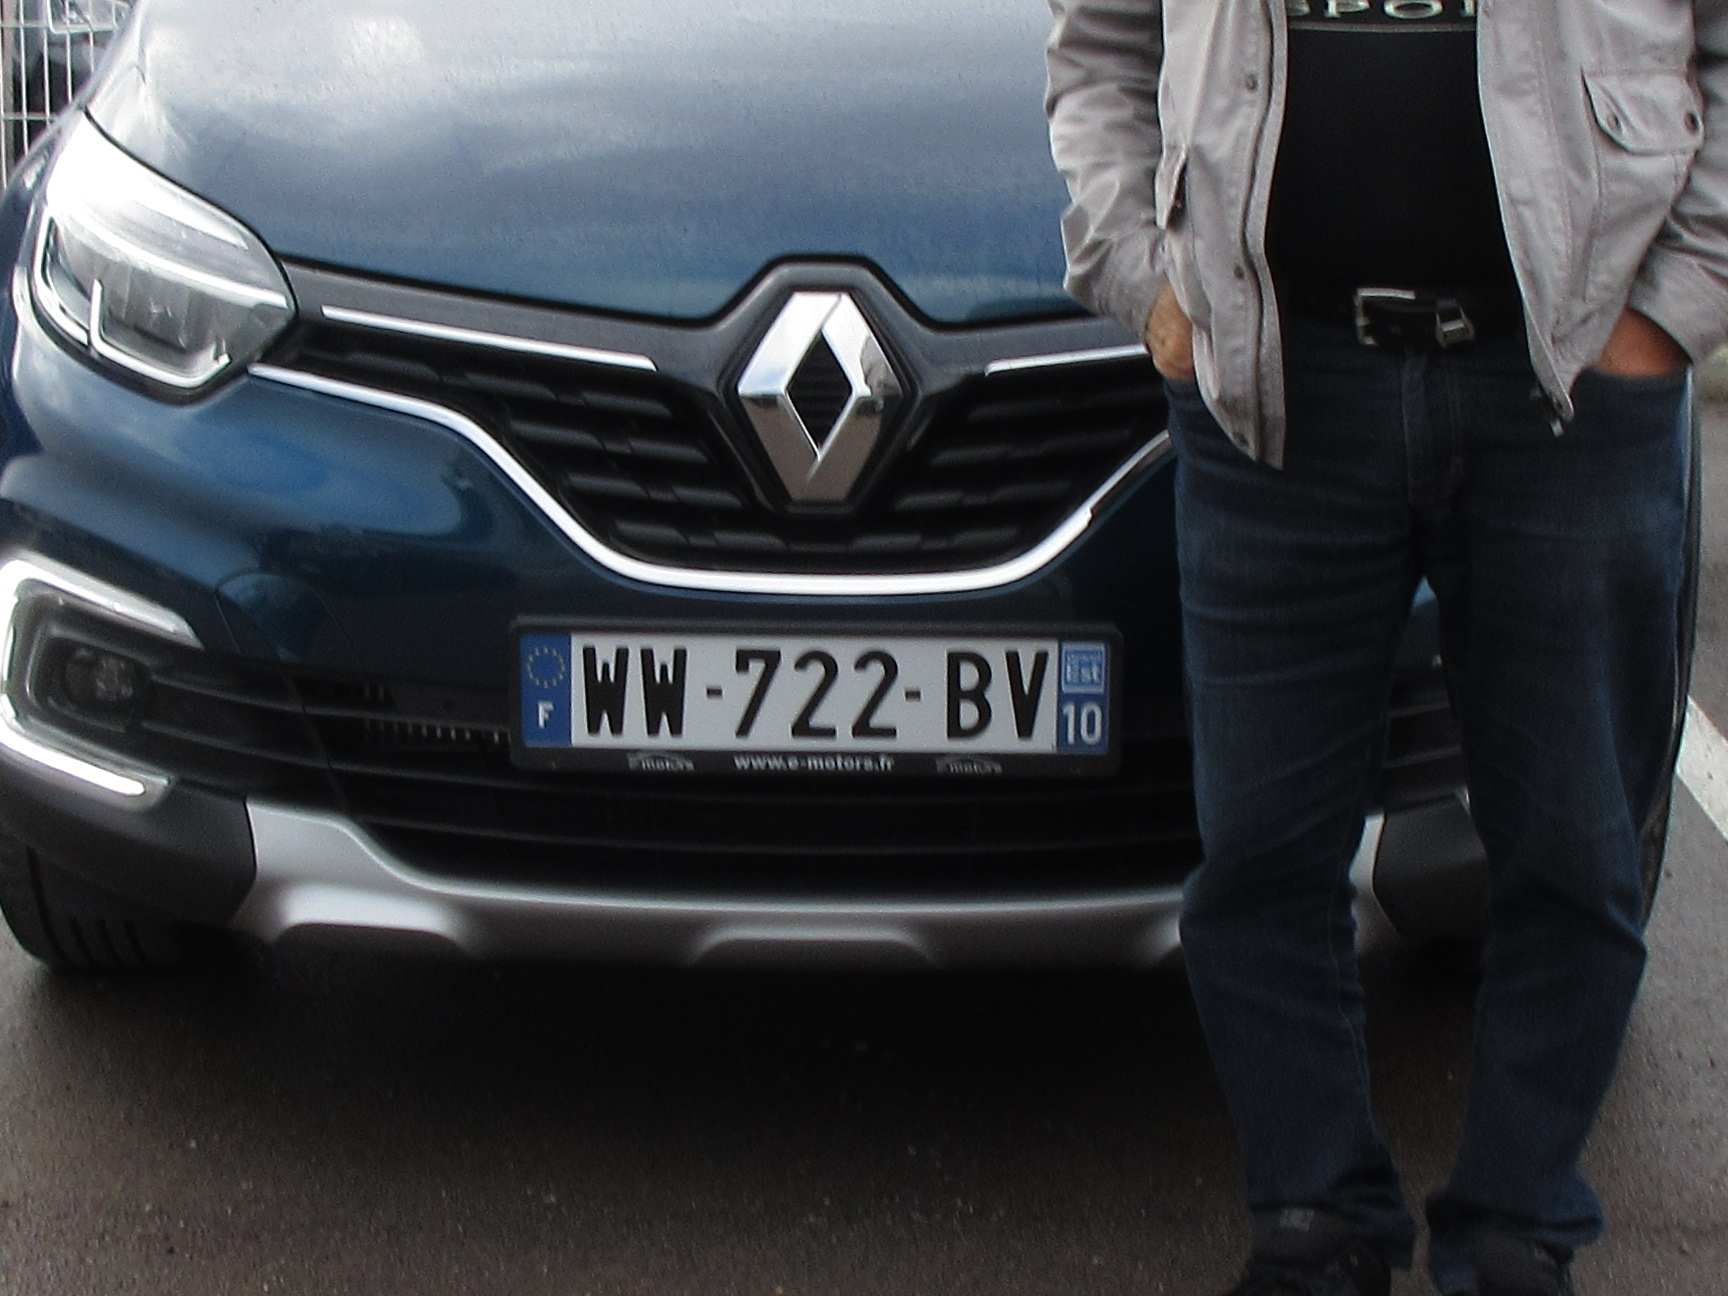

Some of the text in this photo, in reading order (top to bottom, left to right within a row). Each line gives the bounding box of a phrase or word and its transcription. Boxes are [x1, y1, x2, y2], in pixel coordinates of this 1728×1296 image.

[536, 702, 554, 729] F
[1061, 702, 1103, 746] 10
[733, 753, 896, 772] www.e-motors.fr
